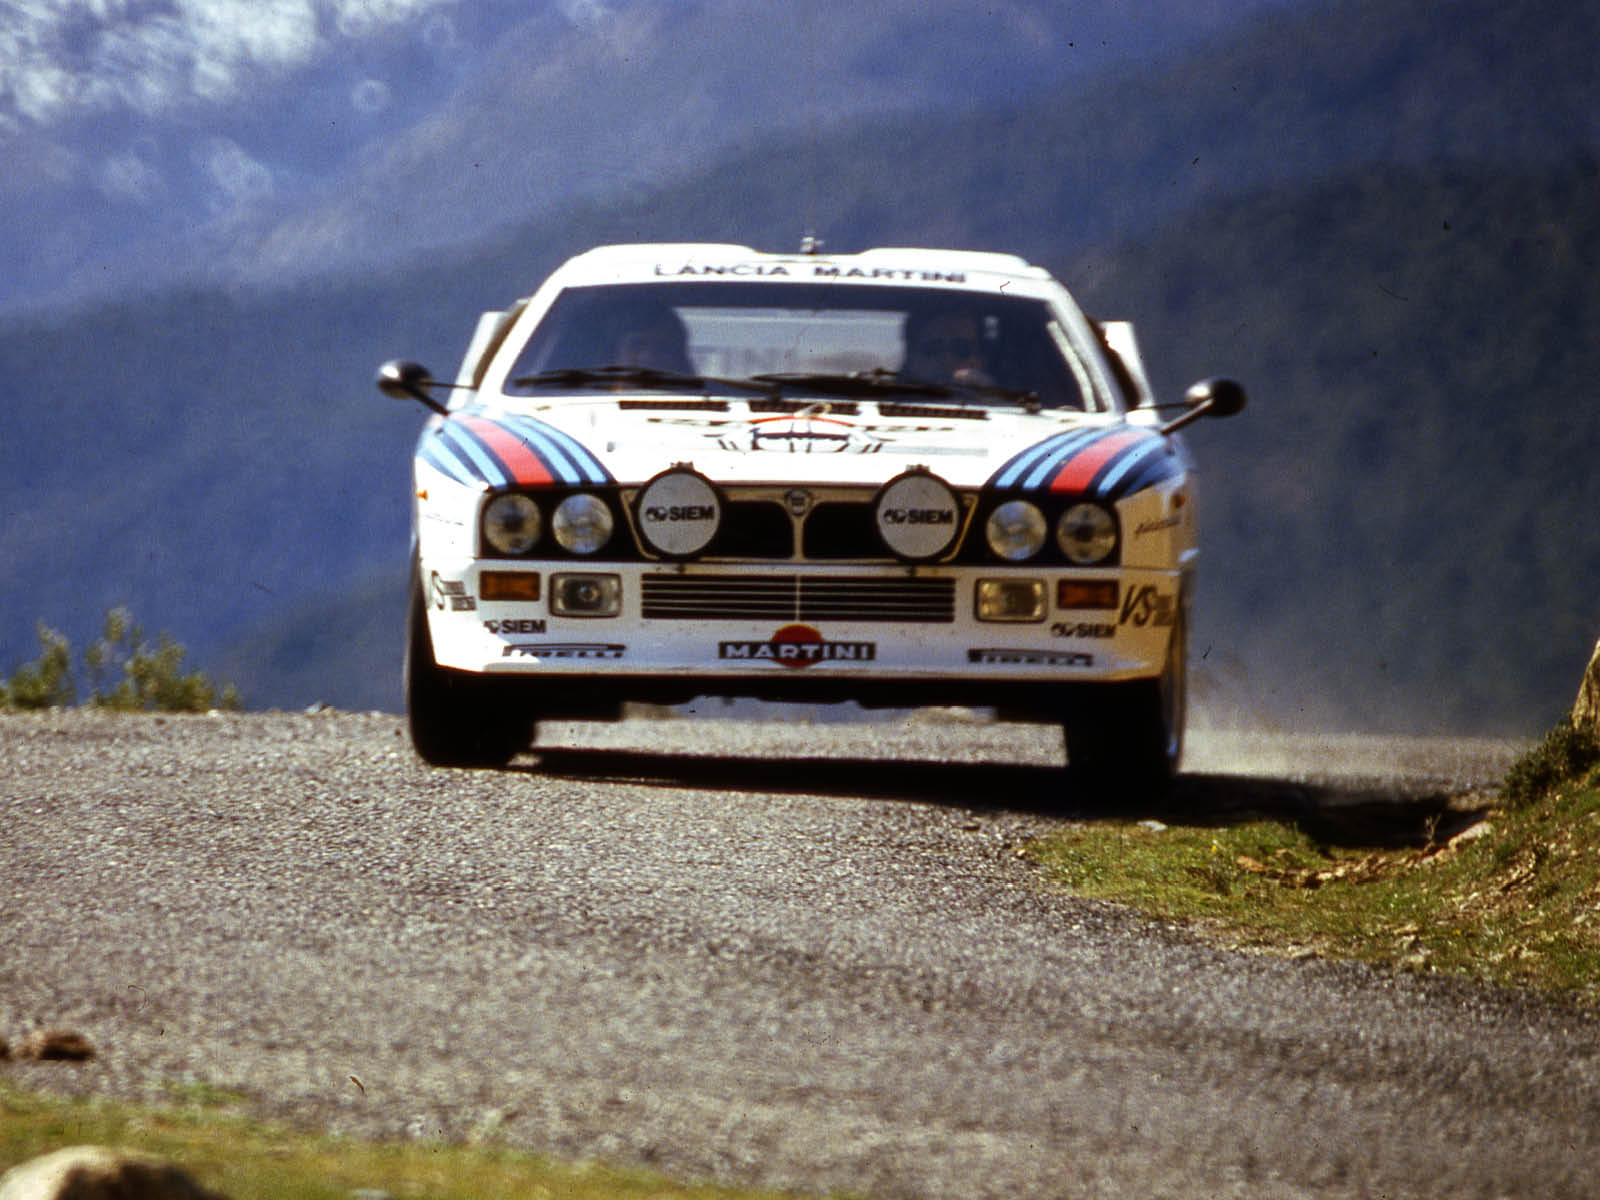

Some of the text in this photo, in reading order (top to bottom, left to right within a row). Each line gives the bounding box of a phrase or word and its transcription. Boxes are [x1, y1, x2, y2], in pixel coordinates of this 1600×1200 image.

[654, 264, 966, 283] LANCIA MARTINI
[669, 505, 715, 520] SIEM
[907, 509, 953, 524] SIEM
[500, 620, 547, 634] SIEM
[724, 643, 872, 660] MARTINI
